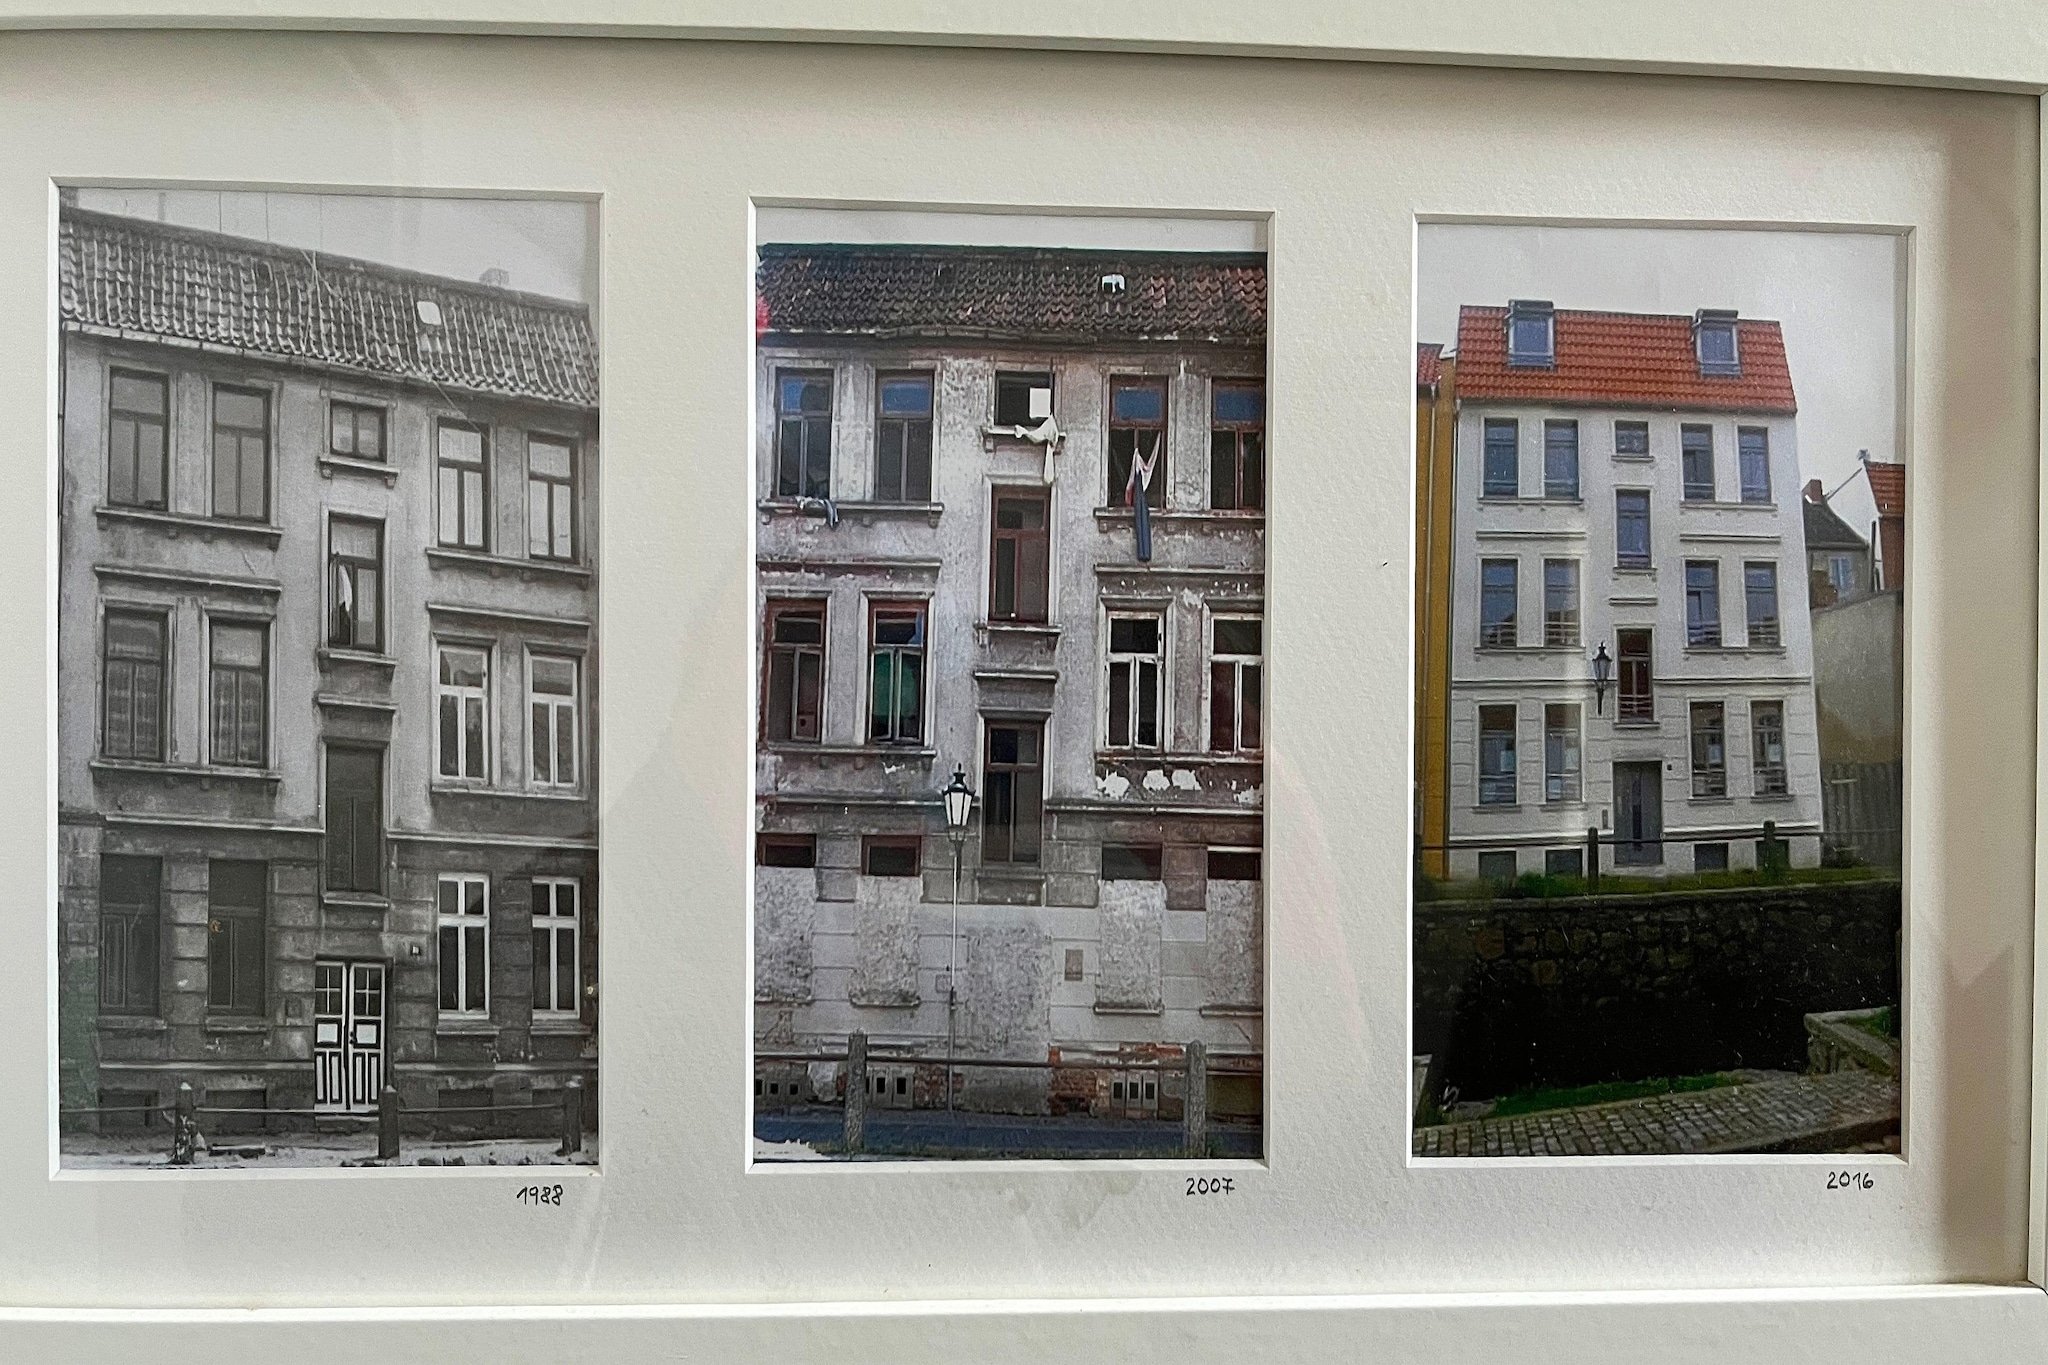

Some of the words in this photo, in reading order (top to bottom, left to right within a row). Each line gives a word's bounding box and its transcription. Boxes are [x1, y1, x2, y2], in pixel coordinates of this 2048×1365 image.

[1185, 1177, 1236, 1196] 2007
[1826, 1170, 1874, 1191] 2016
[516, 1184, 564, 1206] 1988
